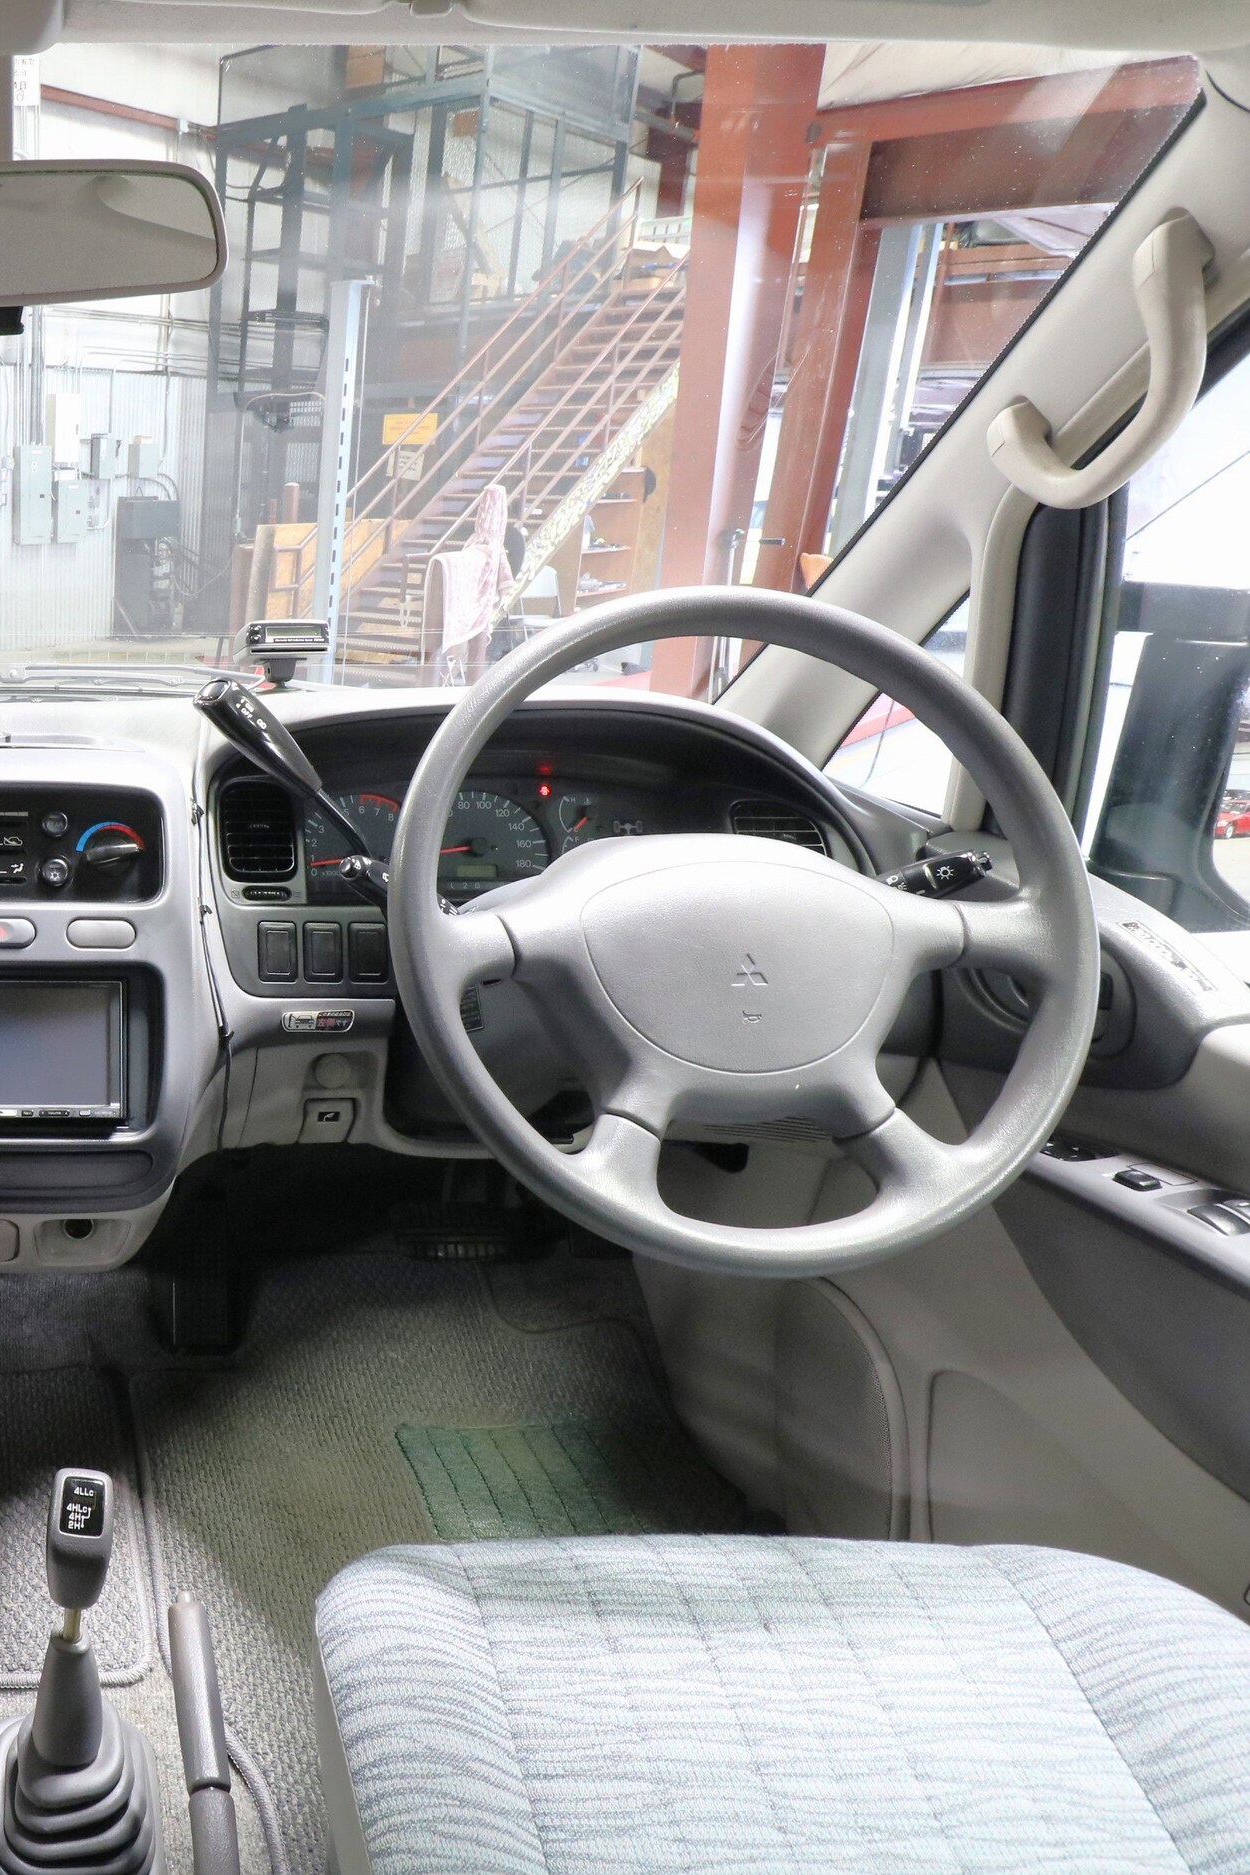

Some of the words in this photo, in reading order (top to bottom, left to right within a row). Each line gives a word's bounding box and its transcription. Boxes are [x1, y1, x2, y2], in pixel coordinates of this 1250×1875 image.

[457, 800, 471, 810] 80
[476, 800, 492, 810] 100
[495, 808, 510, 818] 120
[508, 822, 525, 832] 140
[516, 839, 532, 849] 160
[516, 859, 532, 869] 180
[68, 1512, 81, 1521] 4H
[68, 1520, 81, 1530] 2H
